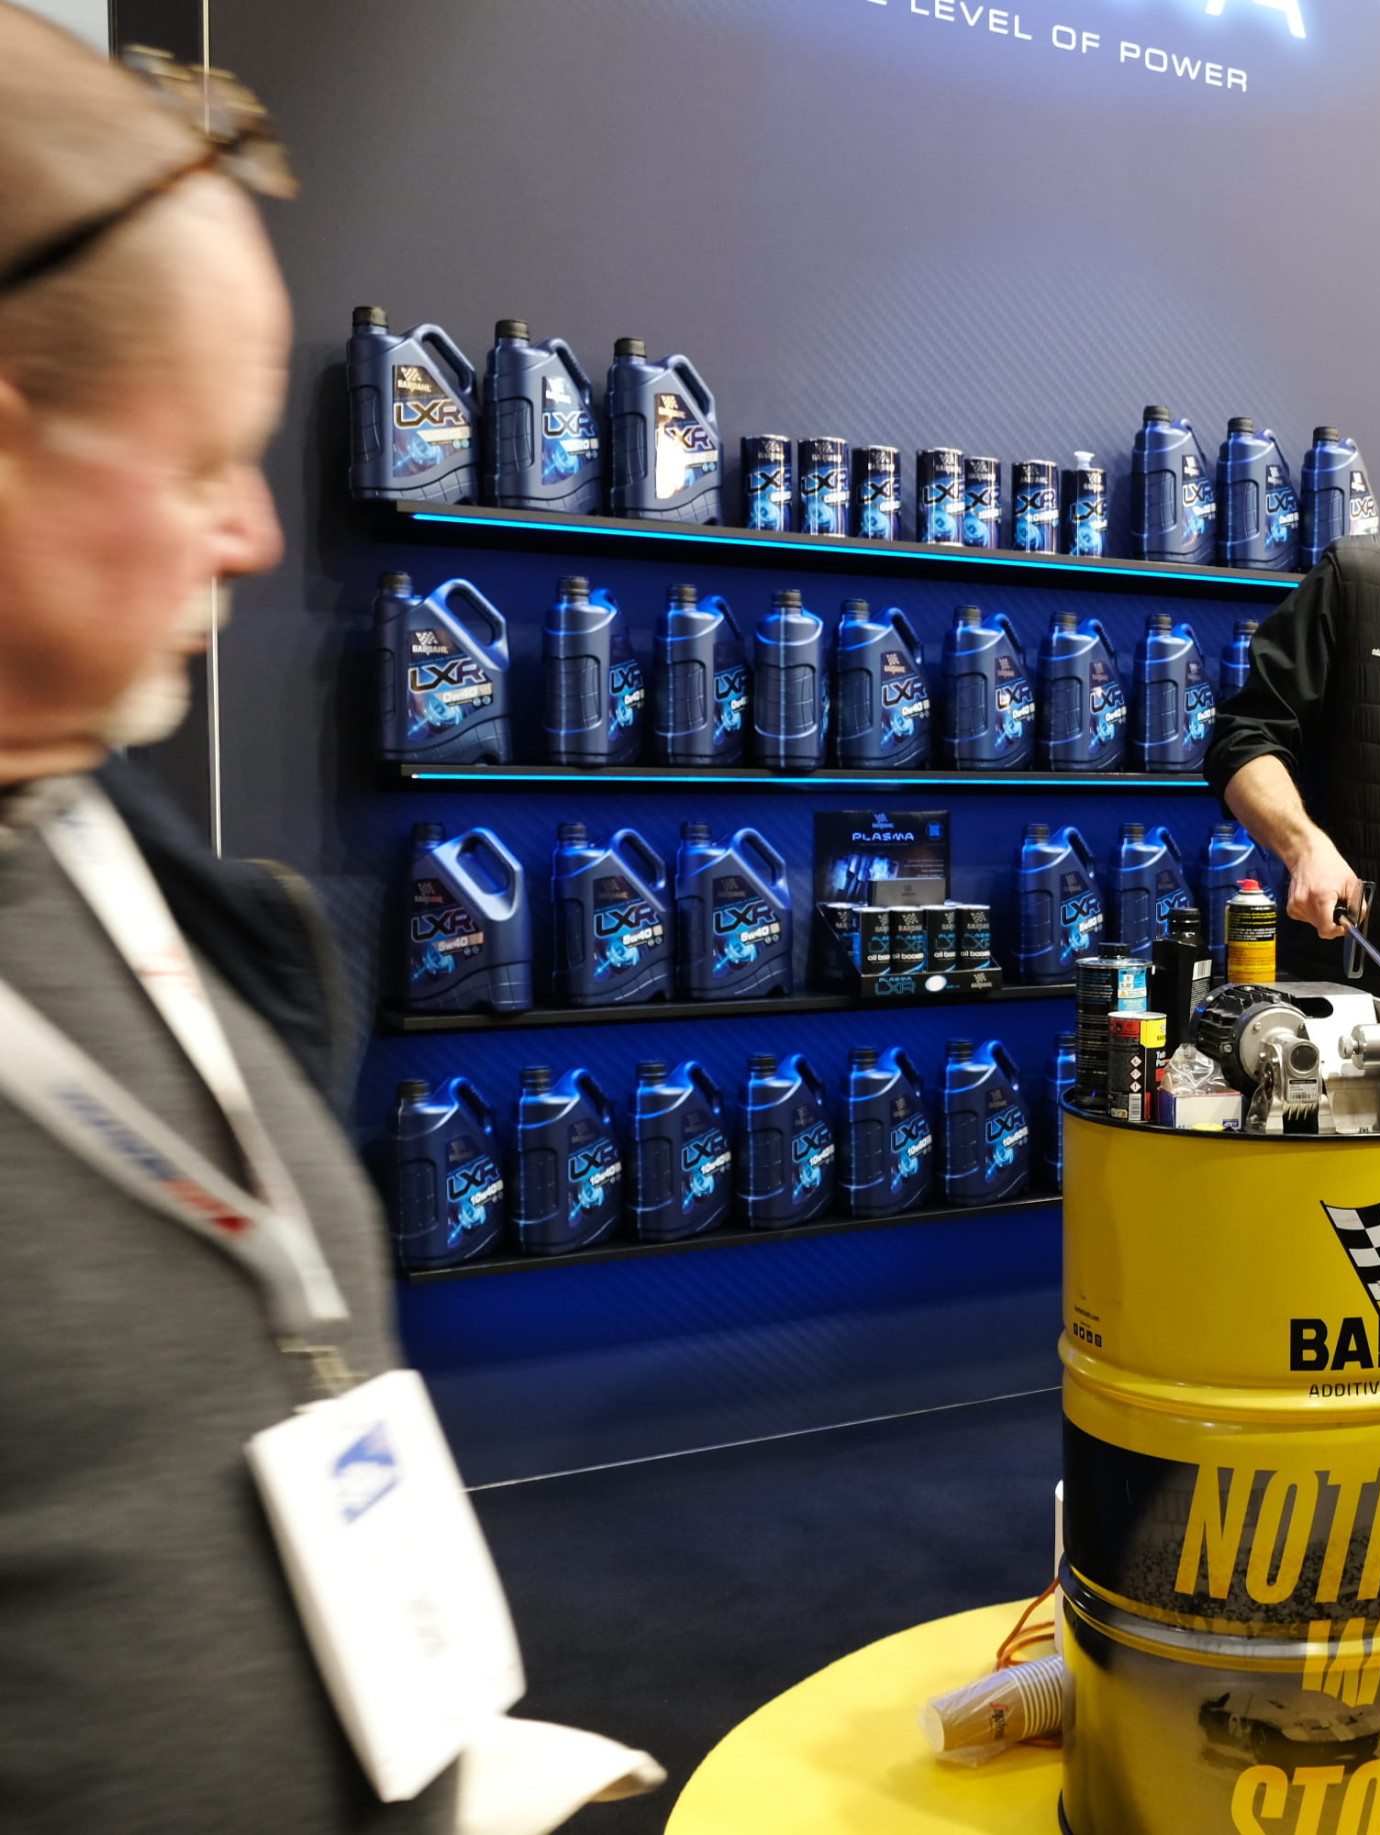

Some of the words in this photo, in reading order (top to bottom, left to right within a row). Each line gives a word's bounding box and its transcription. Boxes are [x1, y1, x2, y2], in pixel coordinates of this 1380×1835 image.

[911, 0, 1032, 40] LEVEL
[1051, 24, 1101, 54] OF
[1119, 40, 1248, 92] POWER
[393, 398, 465, 430] LXR
[542, 410, 596, 440] LXR
[655, 425, 714, 452] XR
[1183, 483, 1215, 507] LXR
[1265, 493, 1298, 514] LXR
[408, 657, 486, 694] LXR
[609, 665, 644, 695] LXR
[881, 679, 927, 708] LXR
[995, 684, 1033, 710] LXR
[1090, 687, 1125, 713] LXR
[1184, 687, 1215, 711] LXR
[852, 832, 915, 842] PLASMA
[411, 907, 477, 943] LXR
[593, 900, 659, 937] LXR
[712, 900, 777, 937] LXR
[1060, 892, 1101, 926] LXR
[890, 1115, 929, 1153] LXR
[985, 1109, 1025, 1144] LXR
[681, 1134, 727, 1171] LXR
[792, 1126, 832, 1164] LXR
[568, 1144, 617, 1182] LXR
[447, 1159, 500, 1202] LXR
